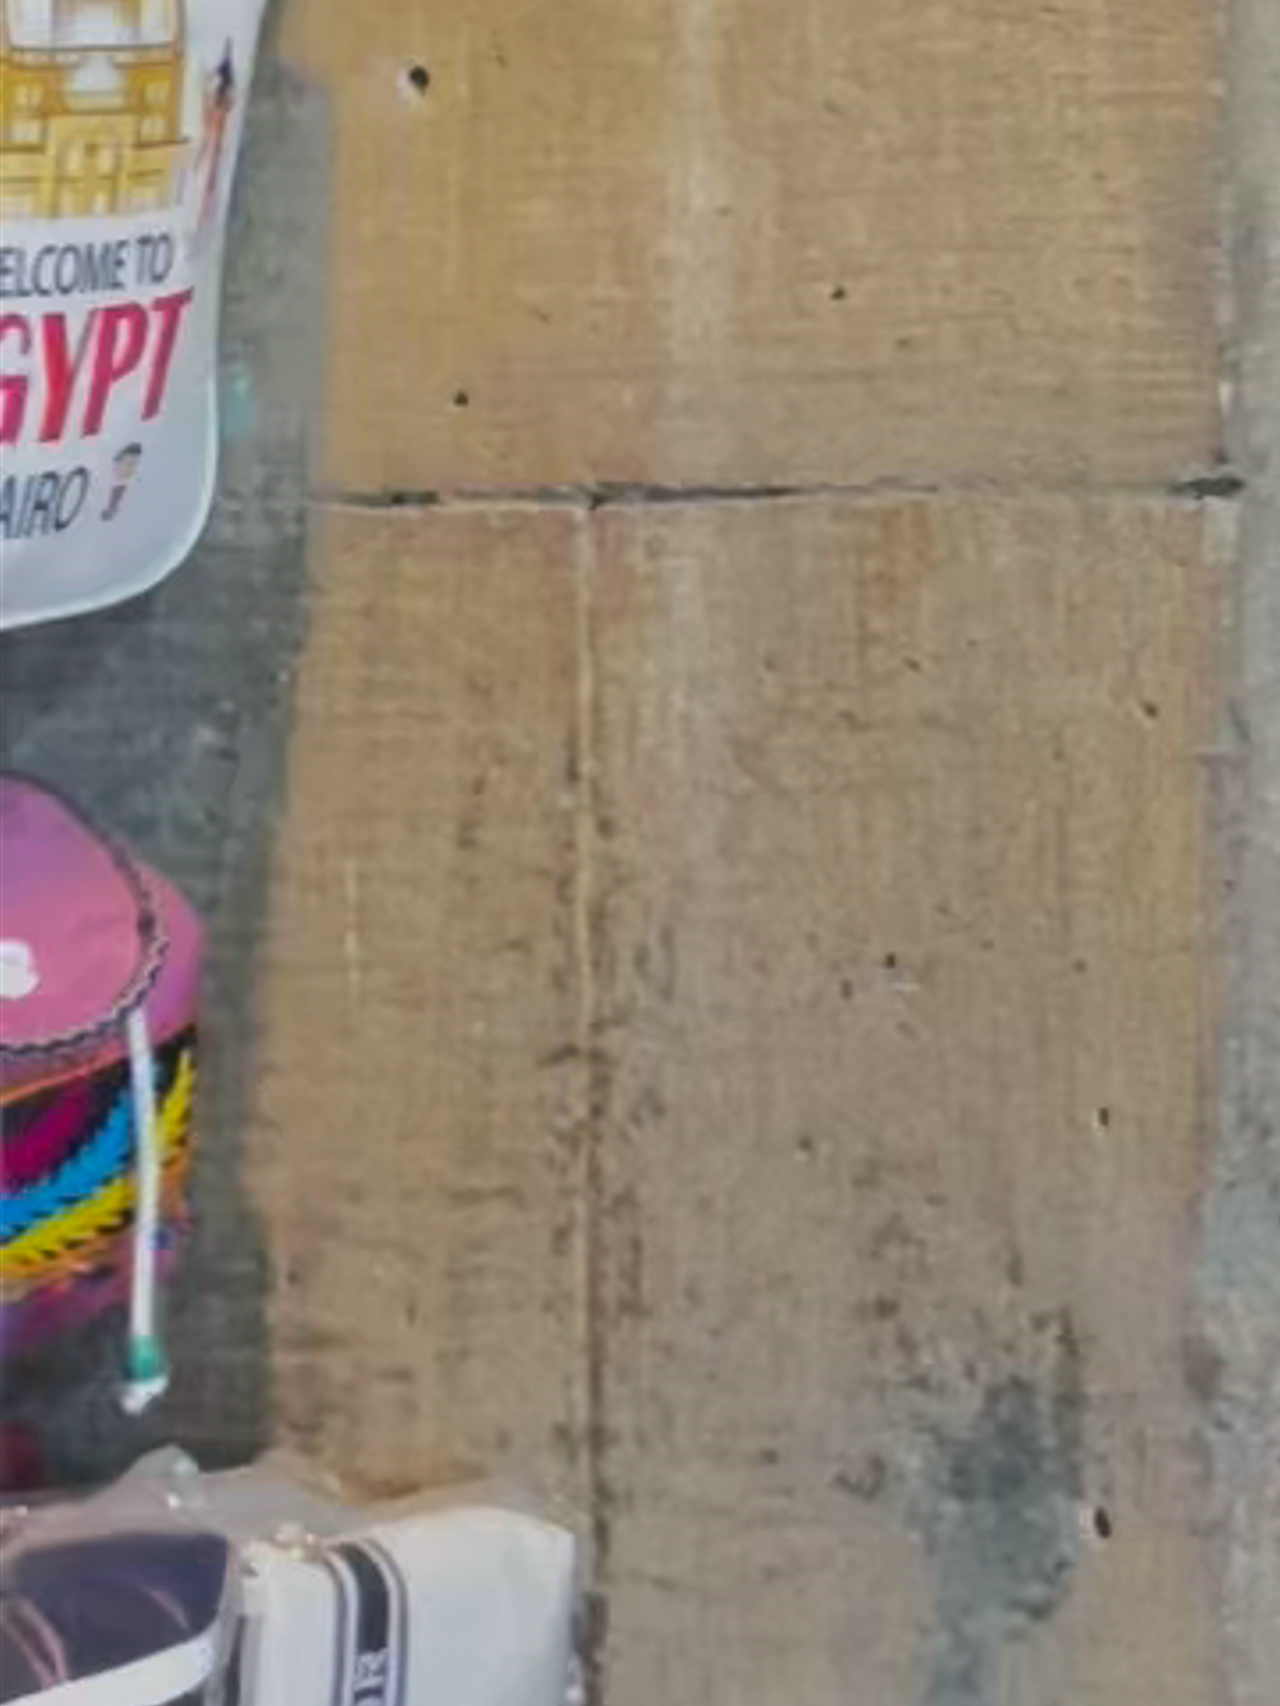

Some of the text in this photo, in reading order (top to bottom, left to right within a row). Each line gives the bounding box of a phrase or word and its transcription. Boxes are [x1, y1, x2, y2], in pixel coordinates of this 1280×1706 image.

[0, 233, 173, 297] ELCOME TO
[0, 287, 195, 444] GYPT
[0, 466, 89, 539] AIRO
